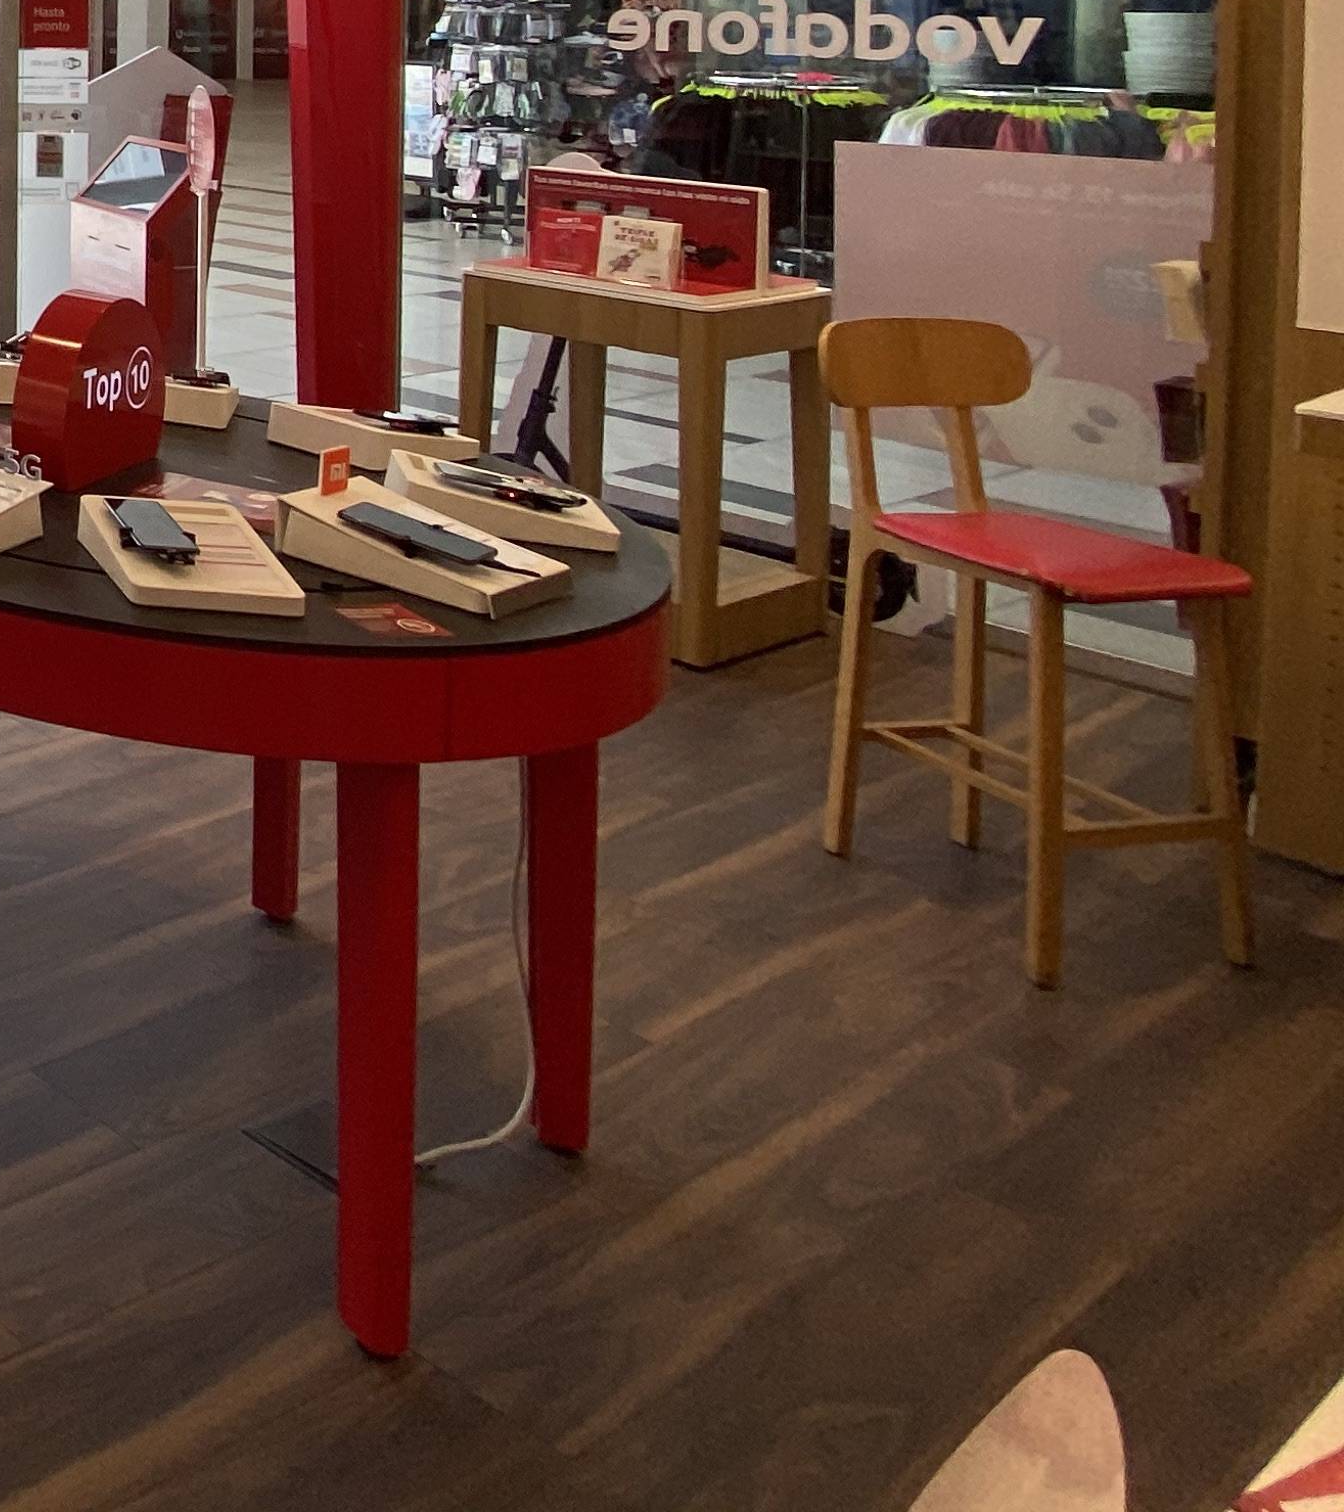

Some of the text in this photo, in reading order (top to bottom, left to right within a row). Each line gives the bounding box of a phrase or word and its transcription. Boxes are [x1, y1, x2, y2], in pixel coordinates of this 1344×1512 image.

[33, 7, 65, 18] Hasta
[33, 21, 70, 33] pronto
[83, 362, 150, 411] Top 10
[3, 446, 42, 481] 5G
